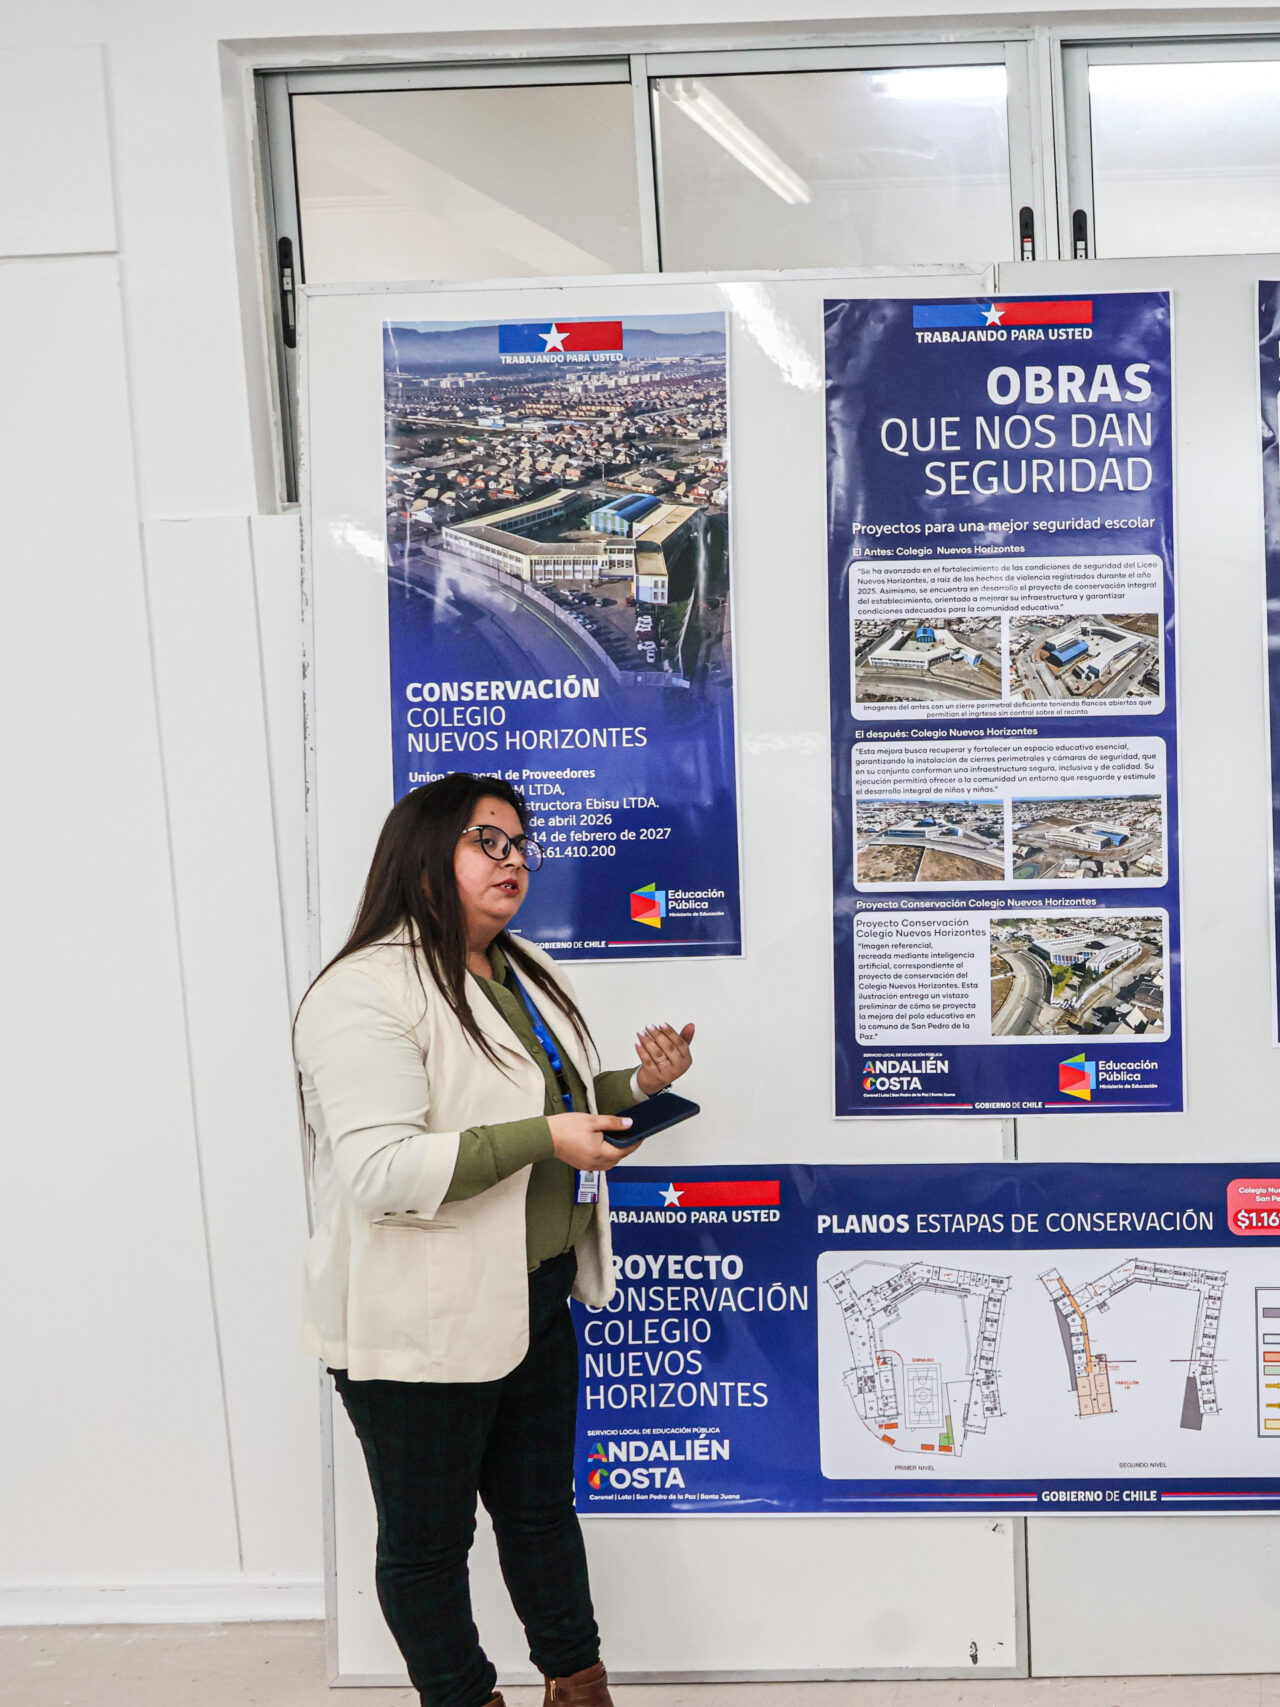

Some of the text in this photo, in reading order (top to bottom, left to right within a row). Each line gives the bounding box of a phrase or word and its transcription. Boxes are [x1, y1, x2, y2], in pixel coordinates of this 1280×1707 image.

[915, 328, 1093, 343] TRABAJANDO PARA USTED
[500, 353, 624, 364] TRABAJANDO PARA USTED
[987, 363, 1152, 405] OBRAS
[881, 412, 1152, 457] QUE NOS DAN
[925, 457, 1152, 498] SEGURIDAD
[852, 516, 1155, 538] Proyectos para una mejor seguridad escolar
[863, 548, 894, 556] Antes:
[896, 547, 933, 557] Colegio
[937, 546, 972, 554] Nuevos
[974, 545, 1025, 554] Horizontes
[406, 674, 599, 702] CONSERVACIÓN
[407, 706, 506, 728] COLEGIO
[408, 727, 647, 752] NUEVOS HORIZONTES
[855, 730, 864, 738] El
[866, 729, 909, 740] después:
[911, 729, 947, 739] Colegio
[987, 727, 1038, 739] Horizontes
[505, 770, 520, 780] de
[522, 768, 595, 780] Proveedores
[529, 784, 565, 796] LTDA,
[526, 797, 659, 811] structora Ebisu LTDA.
[529, 814, 612, 827] de abril 2026
[532, 828, 671, 843] 14 de febrero de 2027
[668, 888, 725, 899] Educación
[668, 900, 708, 909] Pública
[856, 897, 1097, 910] Proyecto Conservación Colegio Nuevos Horizontes
[856, 918, 969, 929] Proyecto Conservación
[856, 928, 986, 940] Colegio Nuevos Horizontes
[858, 962, 892, 970] artificial,
[893, 962, 954, 970] correspondiente
[858, 983, 887, 991] Colegio
[859, 1003, 896, 1011] preliminar
[908, 1013, 925, 1021] polo
[863, 1057, 948, 1074] ANDALIÉN
[1099, 1060, 1158, 1070] Educación
[1099, 1071, 1141, 1081] Pública
[863, 1077, 922, 1091] COSTA
[1238, 1187, 1267, 1195] Colegio
[609, 1209, 780, 1224] ABAJANDO PARA USTED
[818, 1209, 1213, 1234] PLANOS ESTAPAS DE CONSERVACIÓN
[611, 1254, 744, 1280] ROYECTO
[584, 1318, 711, 1346] COLEGIO
[586, 1349, 702, 1378] NUEVOS
[586, 1382, 768, 1410] HORIZONTES
[587, 1434, 729, 1462] ANDALIÉN
[589, 1467, 685, 1489] COSTA
[1041, 1490, 1157, 1502] GOBIERNO DE CHILE
